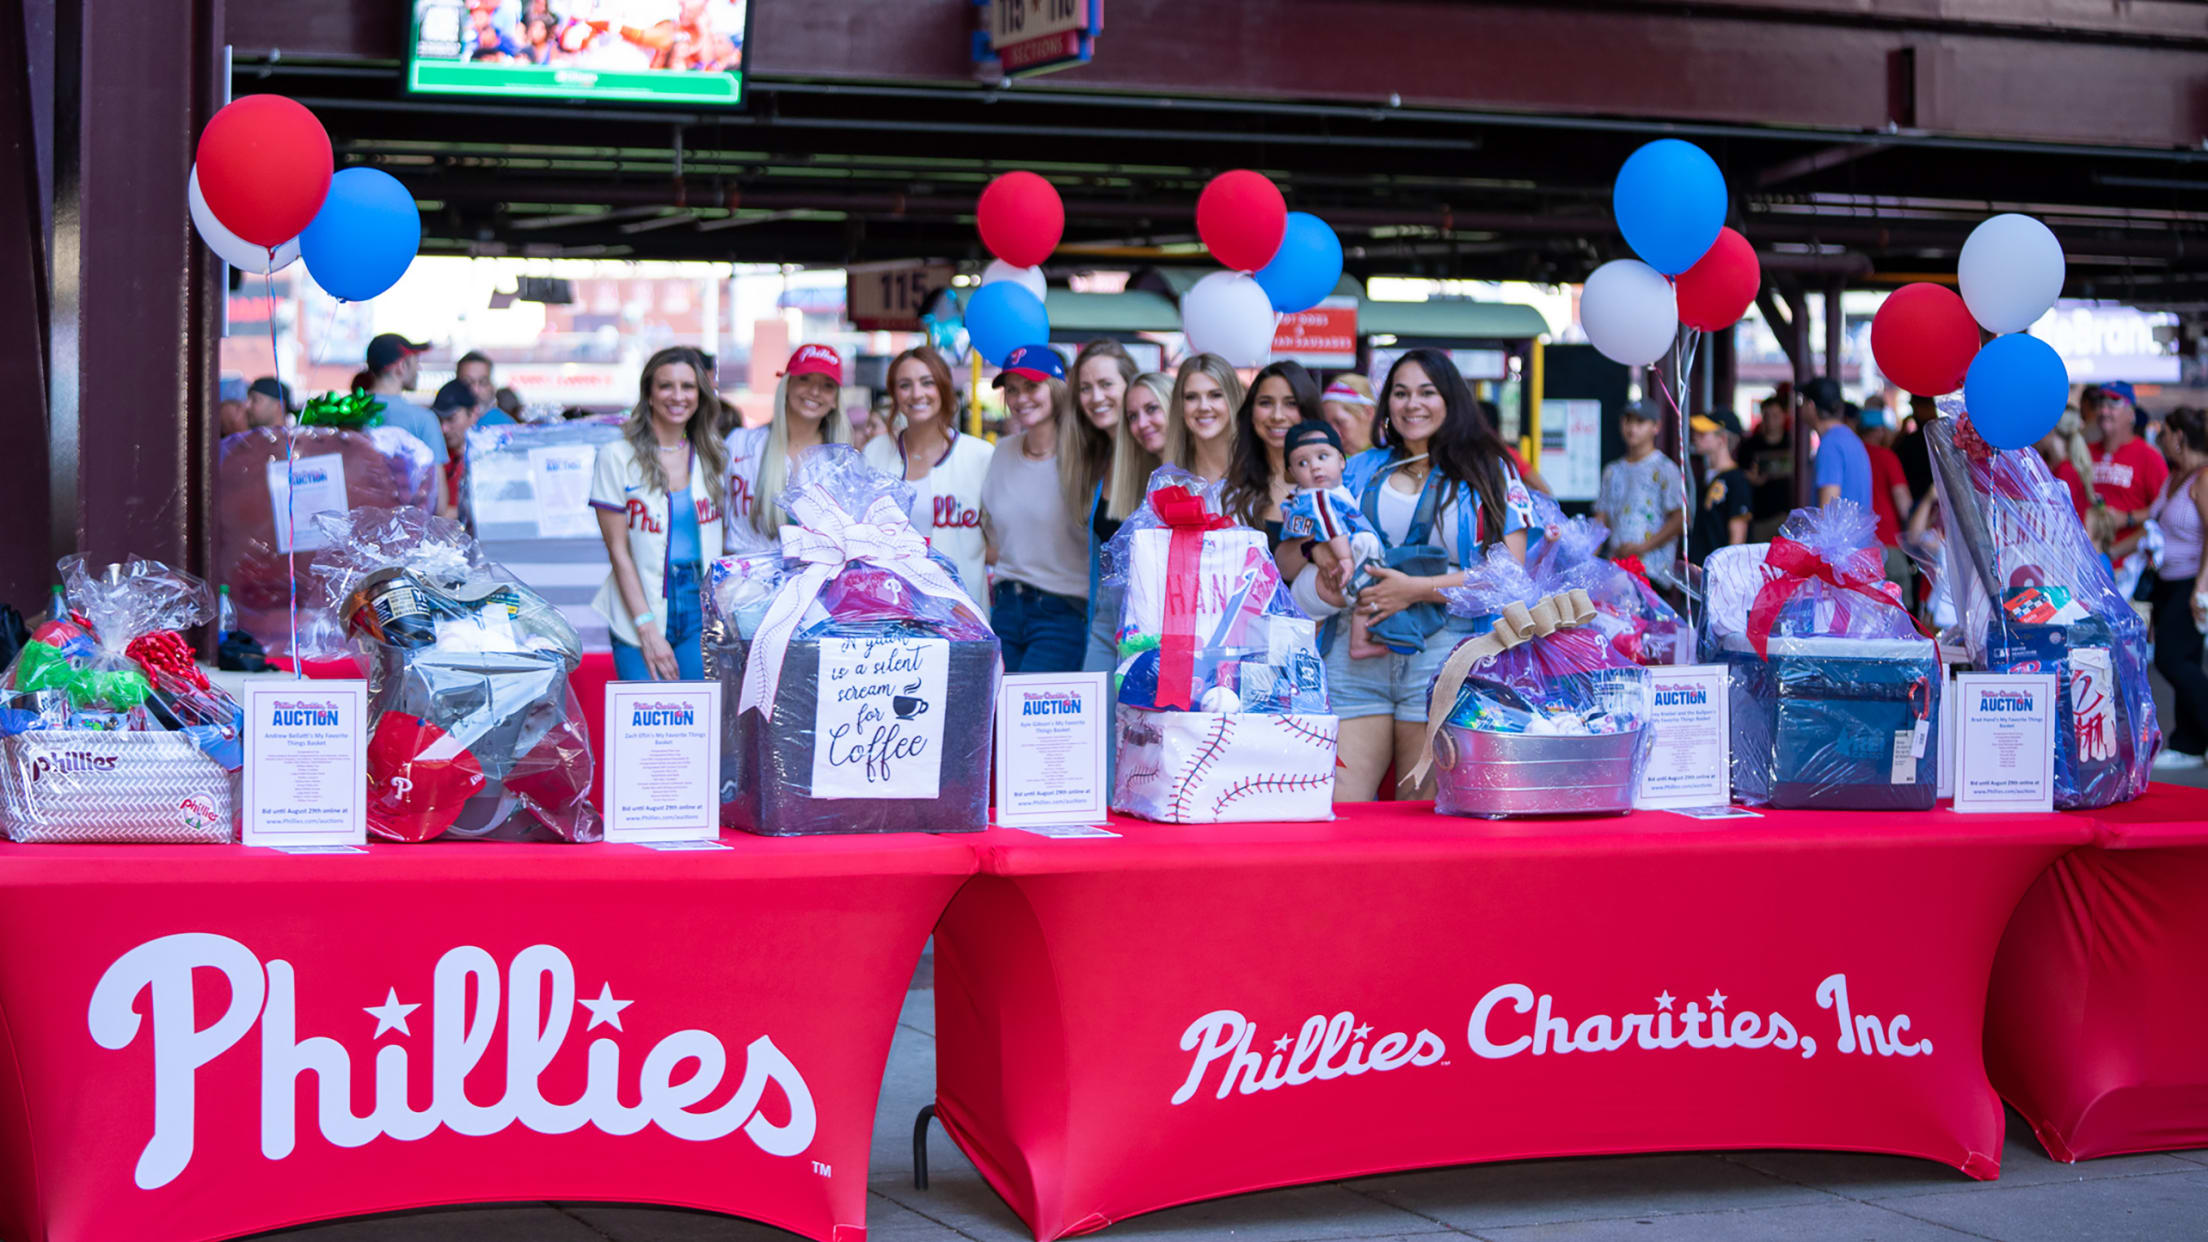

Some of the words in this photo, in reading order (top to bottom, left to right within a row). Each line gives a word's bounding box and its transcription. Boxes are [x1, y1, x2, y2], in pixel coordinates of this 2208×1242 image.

[932, 495, 982, 529] llie
[832, 667, 849, 681] is
[855, 663, 867, 676] a
[873, 645, 932, 675] silent
[838, 683, 896, 703] scream
[1654, 690, 1707, 706] AUCTION
[1980, 698, 2033, 712] AUCTION
[272, 710, 338, 726] AUCTION
[632, 710, 693, 726] AUCTION
[857, 703, 885, 736] for
[1022, 699, 1081, 716] AUCTION
[829, 723, 928, 784] Coffee
[1171, 1008, 1446, 1106] Phillies
[1467, 983, 1817, 1059] Charities,
[1815, 973, 1934, 1057] Inc.
[88, 931, 817, 1190] Phillies
